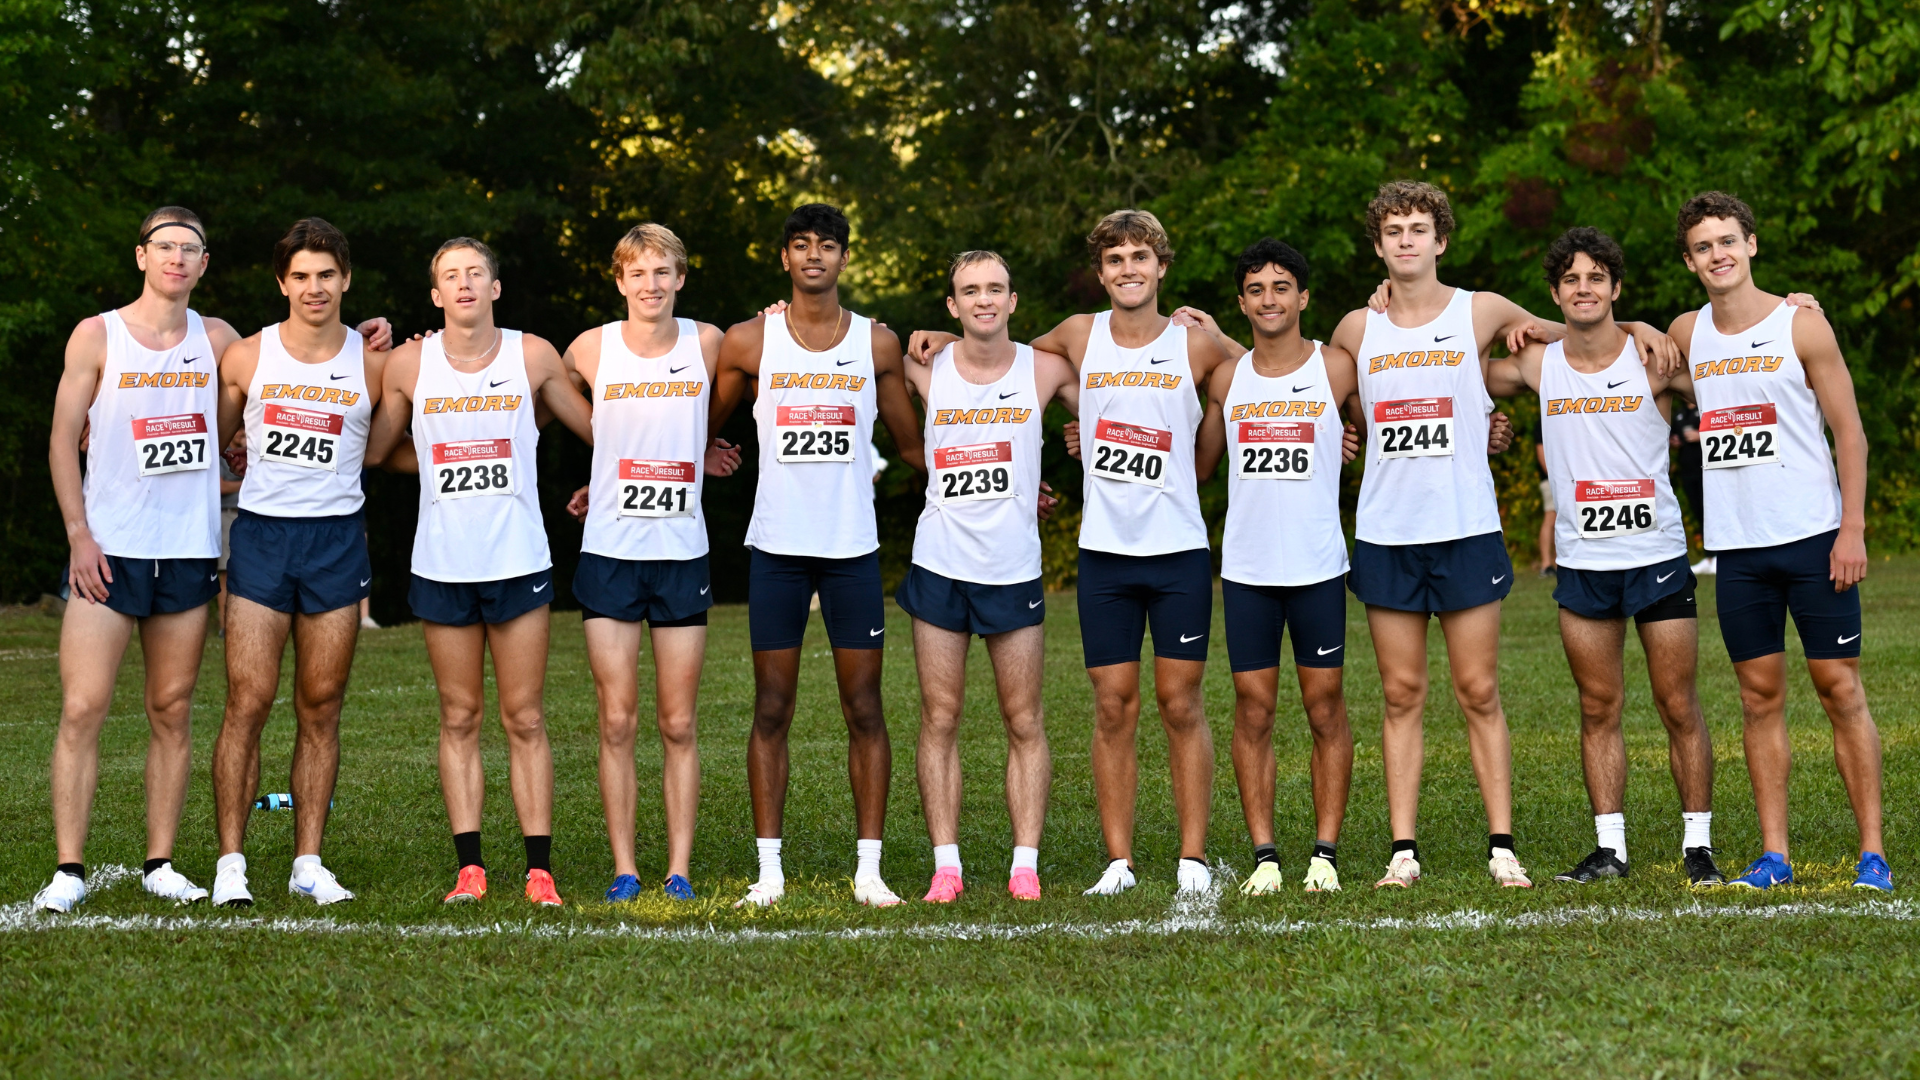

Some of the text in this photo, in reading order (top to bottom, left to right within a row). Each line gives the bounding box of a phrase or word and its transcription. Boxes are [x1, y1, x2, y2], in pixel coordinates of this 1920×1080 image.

[1369, 350, 1465, 375] EMORY
[1694, 356, 1784, 381] EMORY
[118, 372, 210, 389] EMORY
[770, 373, 867, 392] EMORY
[1086, 371, 1182, 390] EMORY
[260, 384, 360, 406] EMORY
[604, 381, 703, 401] EMORY
[424, 395, 522, 414] EMORY
[1230, 401, 1326, 422] EMORY
[1413, 405, 1439, 413] RESULT
[1547, 396, 1643, 416] EMORY
[146, 421, 196, 432] RACE RESULT
[277, 413, 295, 422] RACE
[305, 417, 331, 427] RESULT
[933, 407, 1032, 426] EMORY
[1711, 416, 1727, 424] RACE
[1736, 412, 1762, 421] RESULT
[783, 431, 849, 455] 2235
[1107, 428, 1124, 437] RACE
[1133, 433, 1159, 444] RESULT
[1382, 424, 1449, 452] 2244
[143, 439, 205, 469] 2237
[266, 431, 333, 463] 2245
[444, 446, 498, 457] RACE RESULT
[946, 453, 964, 462] RACE
[973, 450, 998, 458] RESULT
[1706, 431, 1774, 462] 2242
[1095, 446, 1162, 480] 2240
[1243, 448, 1308, 473] 2236
[440, 464, 508, 493] 2238
[659, 468, 685, 476] RESULT
[942, 468, 1008, 498] 2239
[623, 485, 686, 511] 2241
[1582, 504, 1652, 531] 2246
